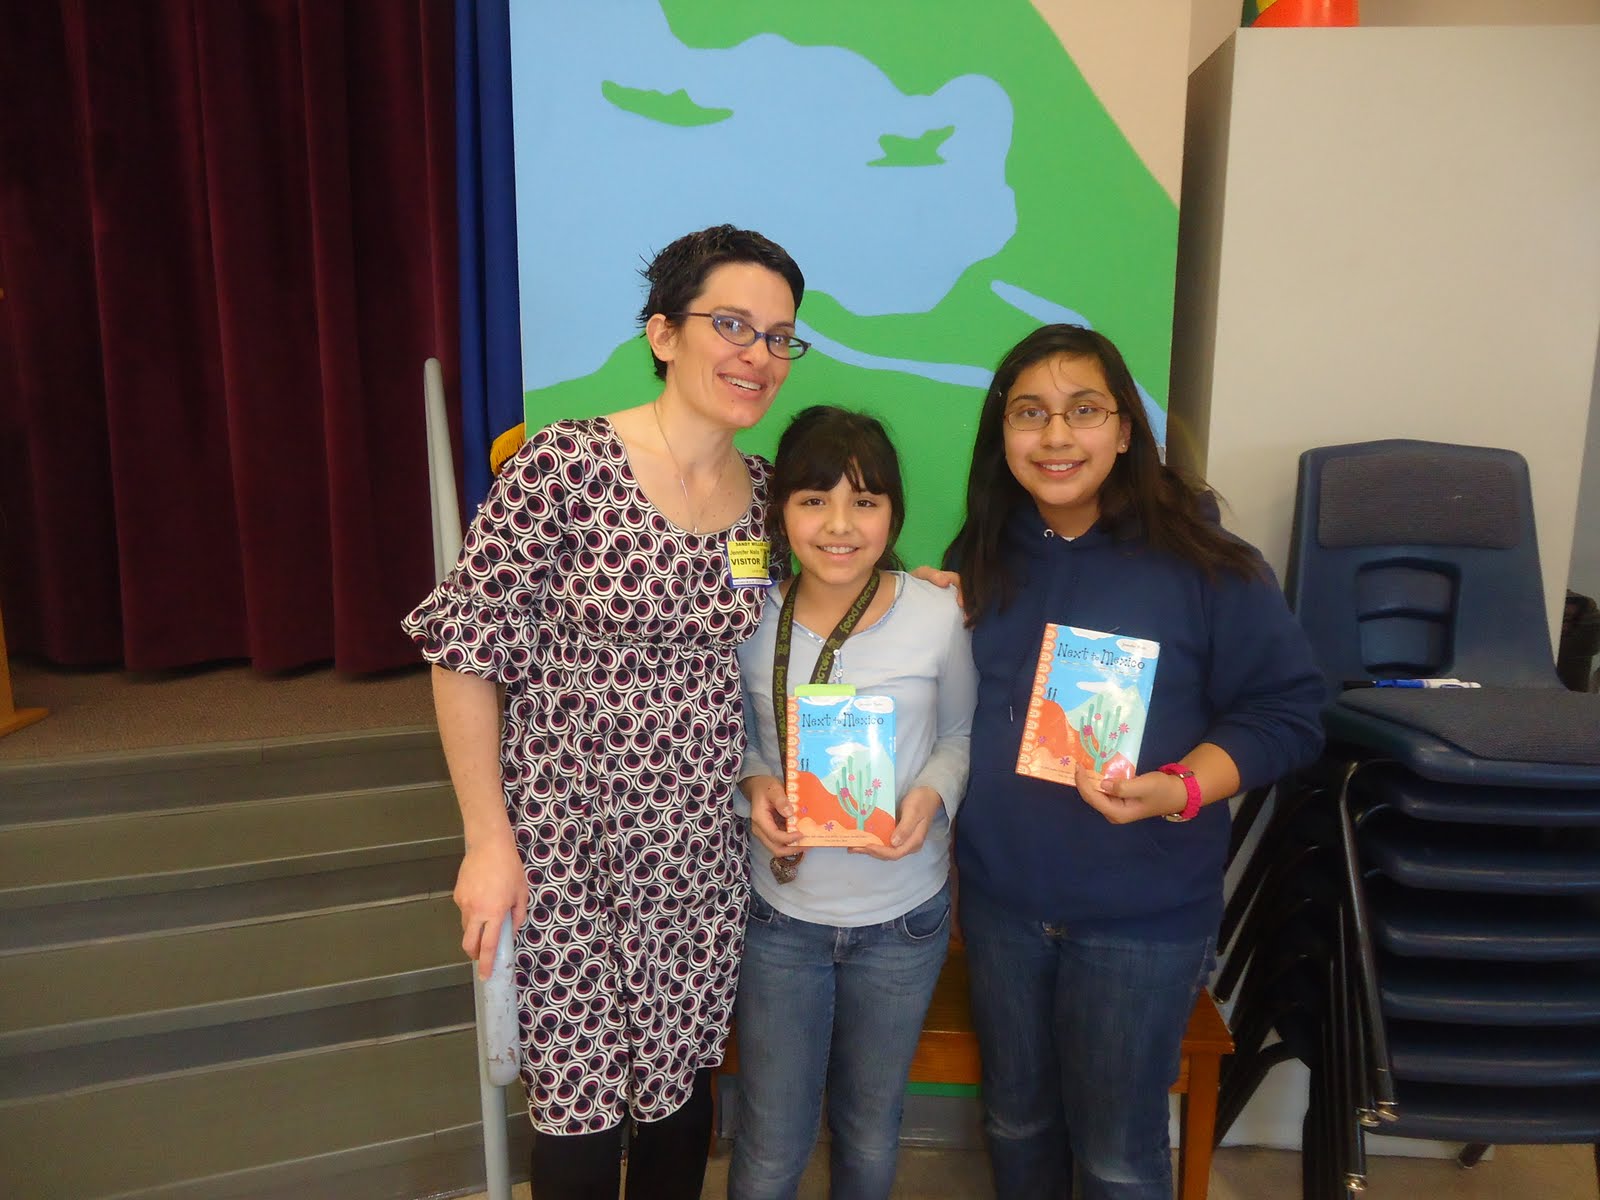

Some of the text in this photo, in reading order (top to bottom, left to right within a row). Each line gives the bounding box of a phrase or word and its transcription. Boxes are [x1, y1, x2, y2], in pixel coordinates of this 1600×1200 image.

[731, 557, 761, 566] VISITOR
[839, 607, 860, 634] food
[1057, 642, 1145, 670] Next to Mexico
[802, 712, 884, 728] Next to Mexico
